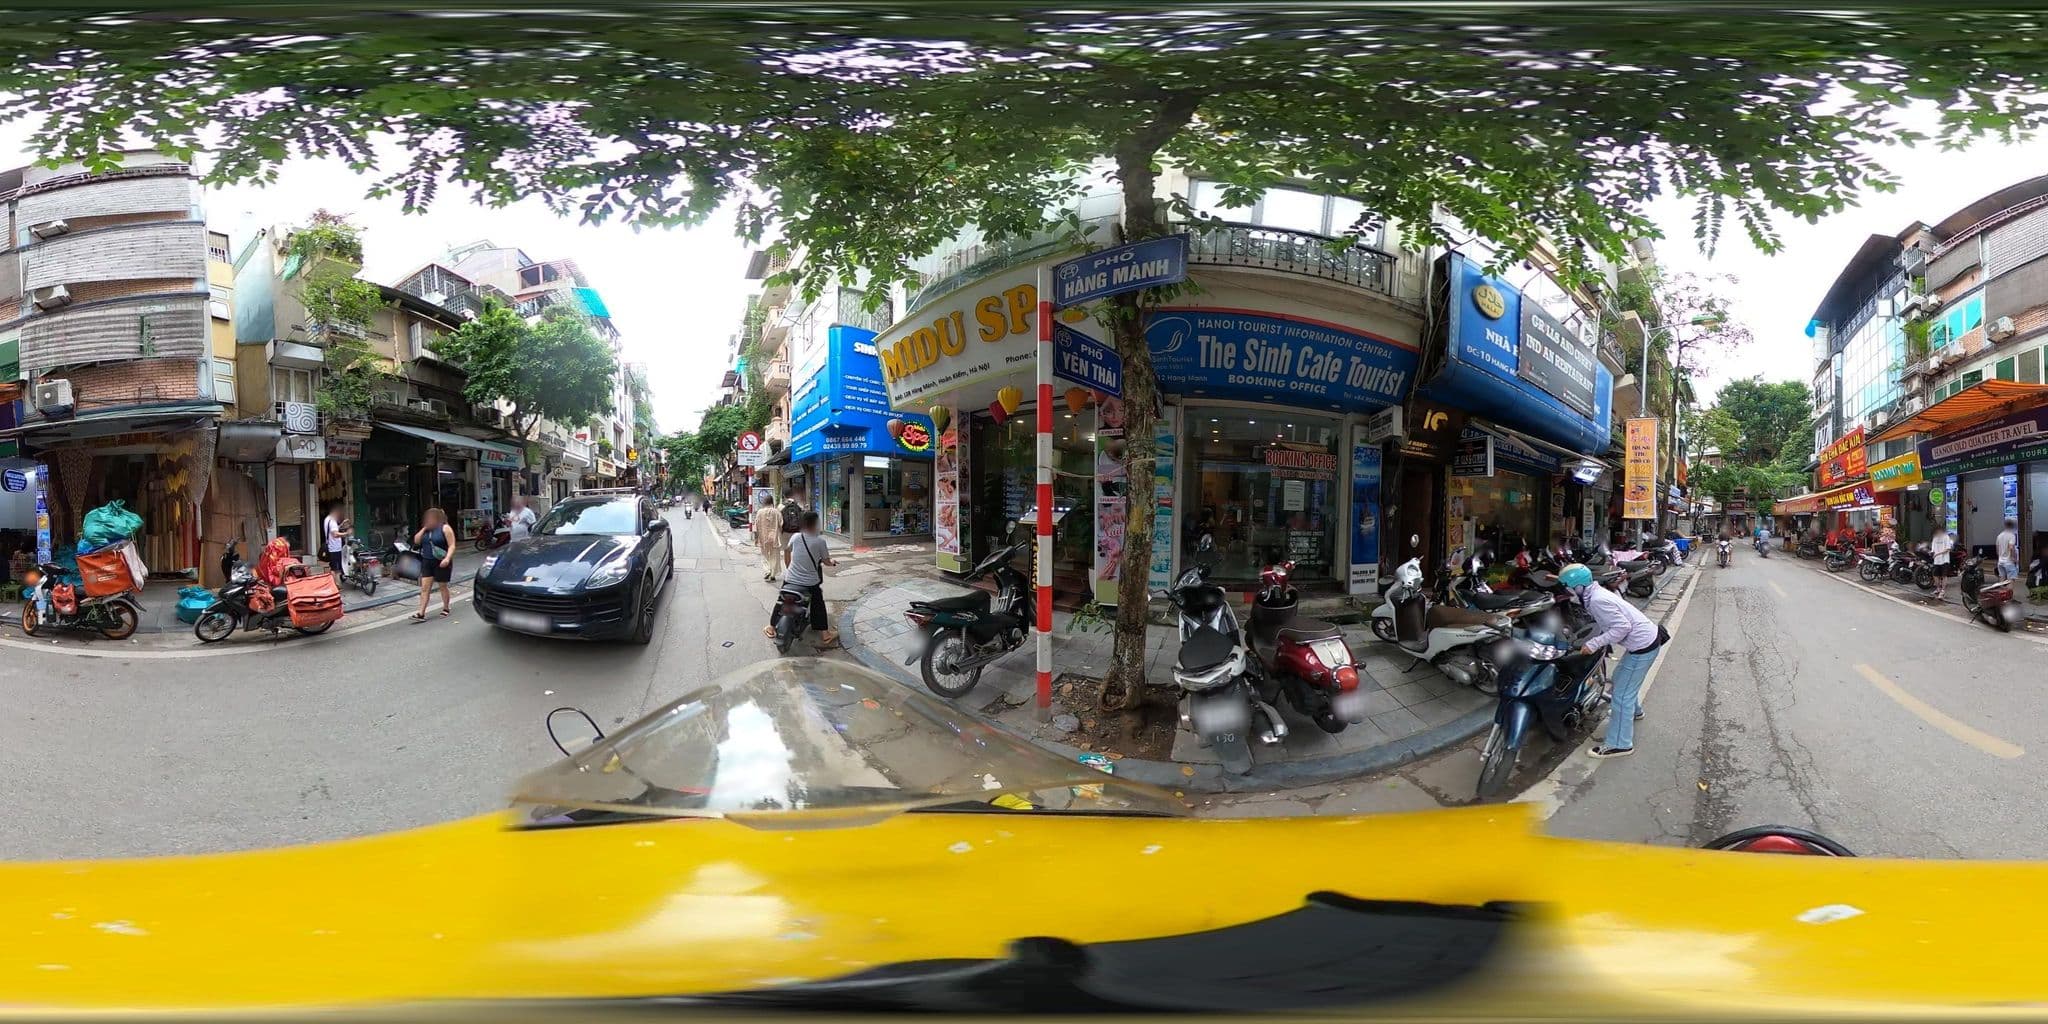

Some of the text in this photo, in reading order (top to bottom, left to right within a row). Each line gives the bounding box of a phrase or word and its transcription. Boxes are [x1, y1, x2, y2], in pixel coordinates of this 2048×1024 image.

[1094, 247, 1135, 269] PHỐ
[1064, 272, 1107, 299] HÀNG
[881, 283, 1038, 384] MIDU SP
[1198, 318, 1392, 360] HANOI TOURIST INFORMATION CENTRAL
[1485, 328, 1510, 352] NHÀ
[1005, 351, 1032, 364] Phone:
[1062, 351, 1089, 377] YÊN
[1197, 335, 1405, 397] The Sinh Cafe Tourist
[1227, 374, 1328, 395] BOOKING OFFICE
[903, 424, 929, 444] Spa
[1953, 440, 1967, 452] OLD
[1968, 435, 2000, 448] QUARTER
[2001, 423, 2033, 440] TRAVEL
[1266, 450, 1306, 468] BOOKING
[1308, 452, 1337, 471] OFFICE
